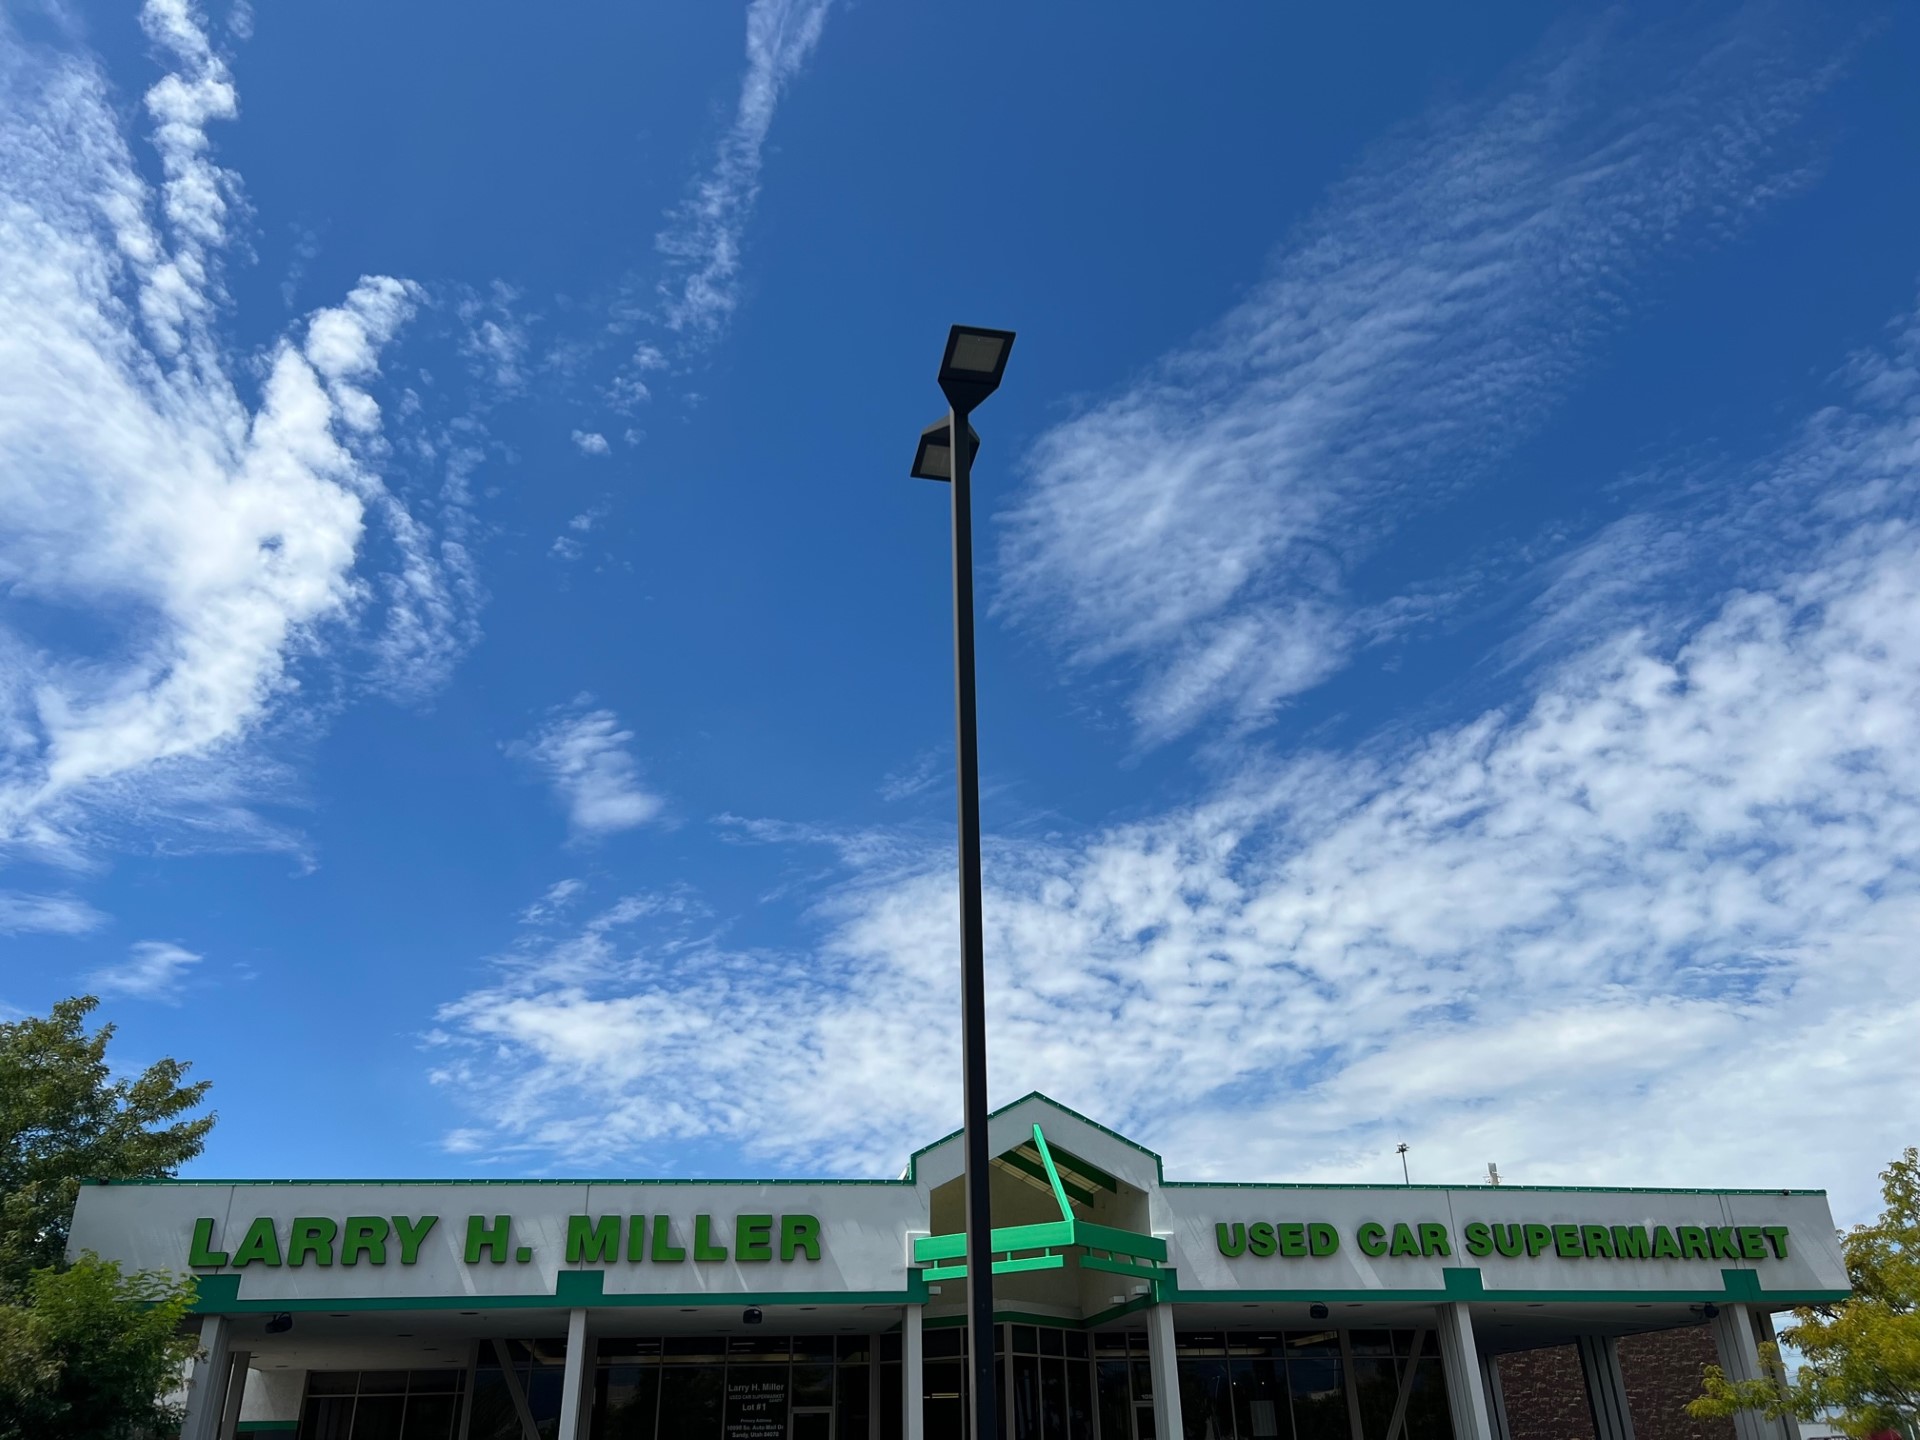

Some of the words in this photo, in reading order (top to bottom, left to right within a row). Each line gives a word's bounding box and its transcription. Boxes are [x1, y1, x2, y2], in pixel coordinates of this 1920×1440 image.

[188, 1215, 439, 1268] LARRY
[463, 1214, 532, 1264] H.
[564, 1214, 822, 1264] MILLER
[1215, 1222, 1340, 1258] USED
[1357, 1222, 1451, 1257] CAR
[1465, 1222, 1790, 1260] SUPERMARKET
[728, 1384, 750, 1393] Larry
[751, 1383, 760, 1391] H.
[762, 1383, 784, 1391] Miller
[742, 1403, 755, 1411] Lot
